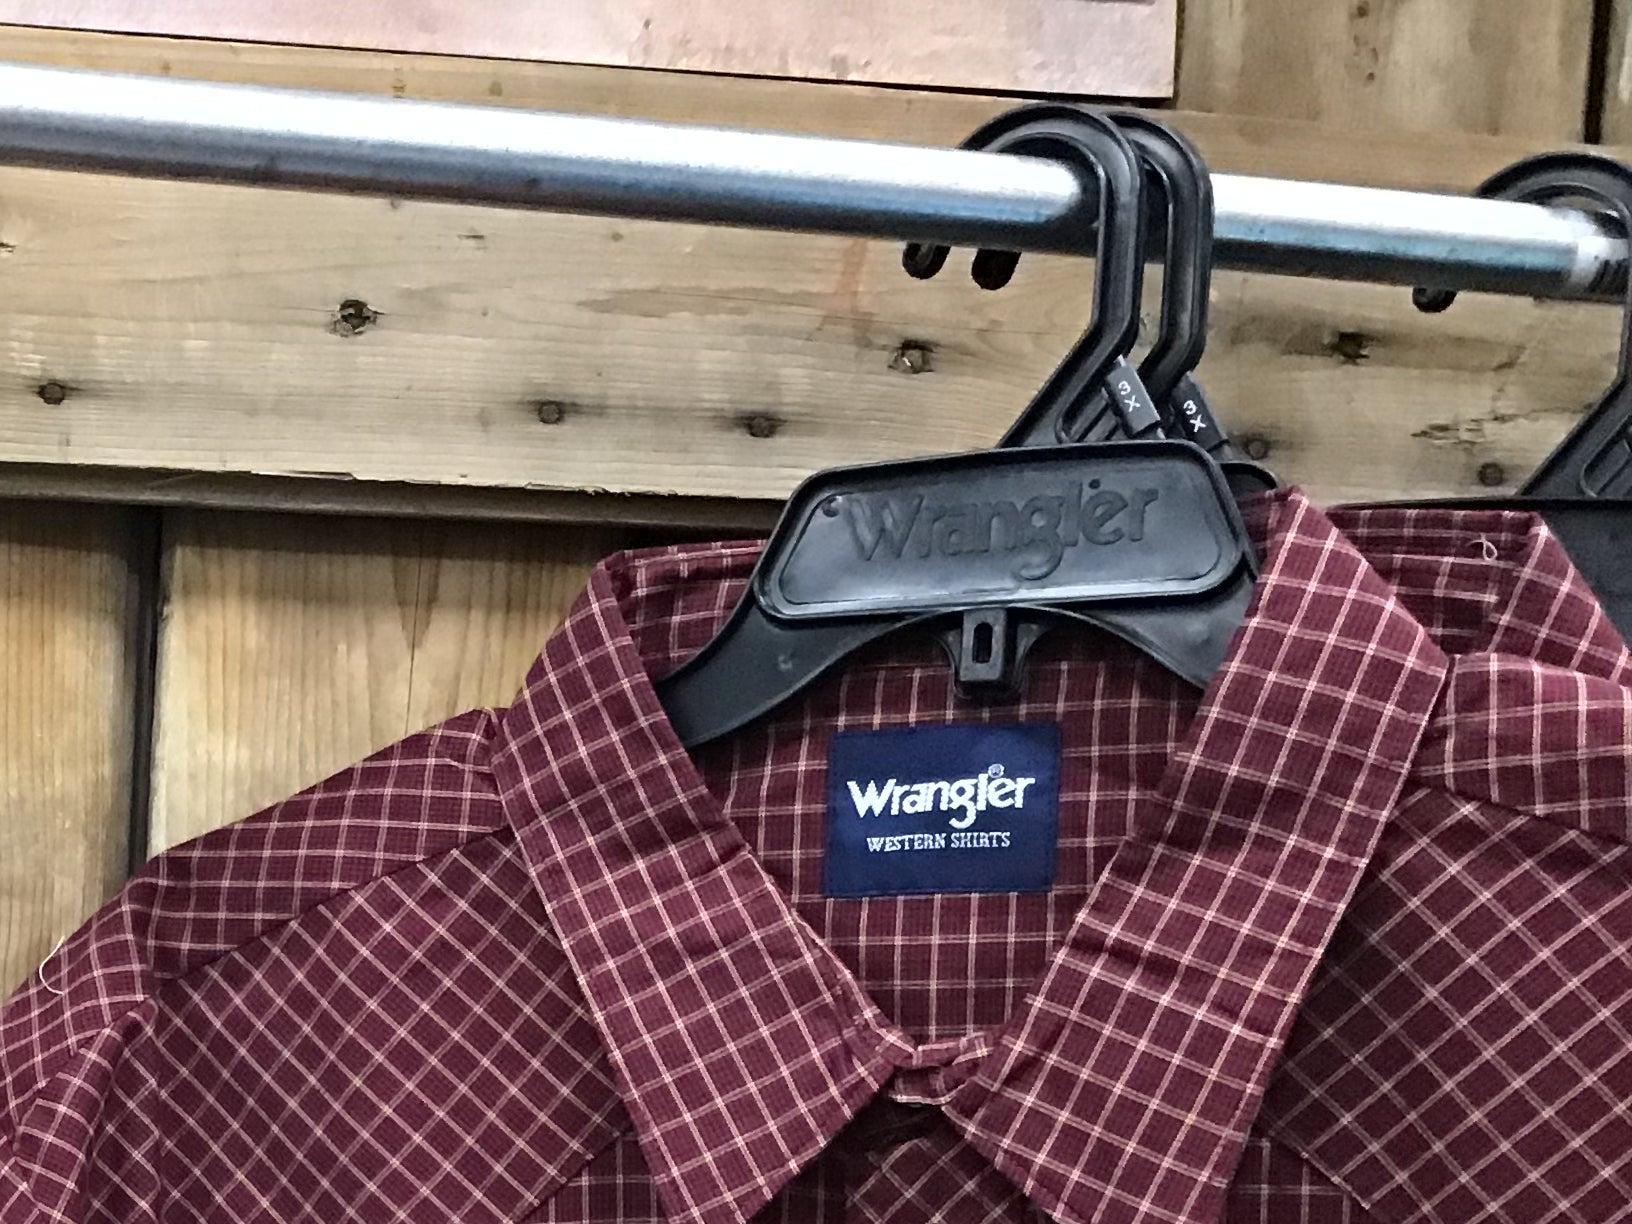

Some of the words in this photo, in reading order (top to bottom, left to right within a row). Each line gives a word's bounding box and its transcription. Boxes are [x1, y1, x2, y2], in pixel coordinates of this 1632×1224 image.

[844, 480, 1159, 581] Wrangler
[846, 772, 1036, 829] Wrangler
[866, 832, 947, 852] WESTERN
[950, 831, 1011, 849] SHIRTS
